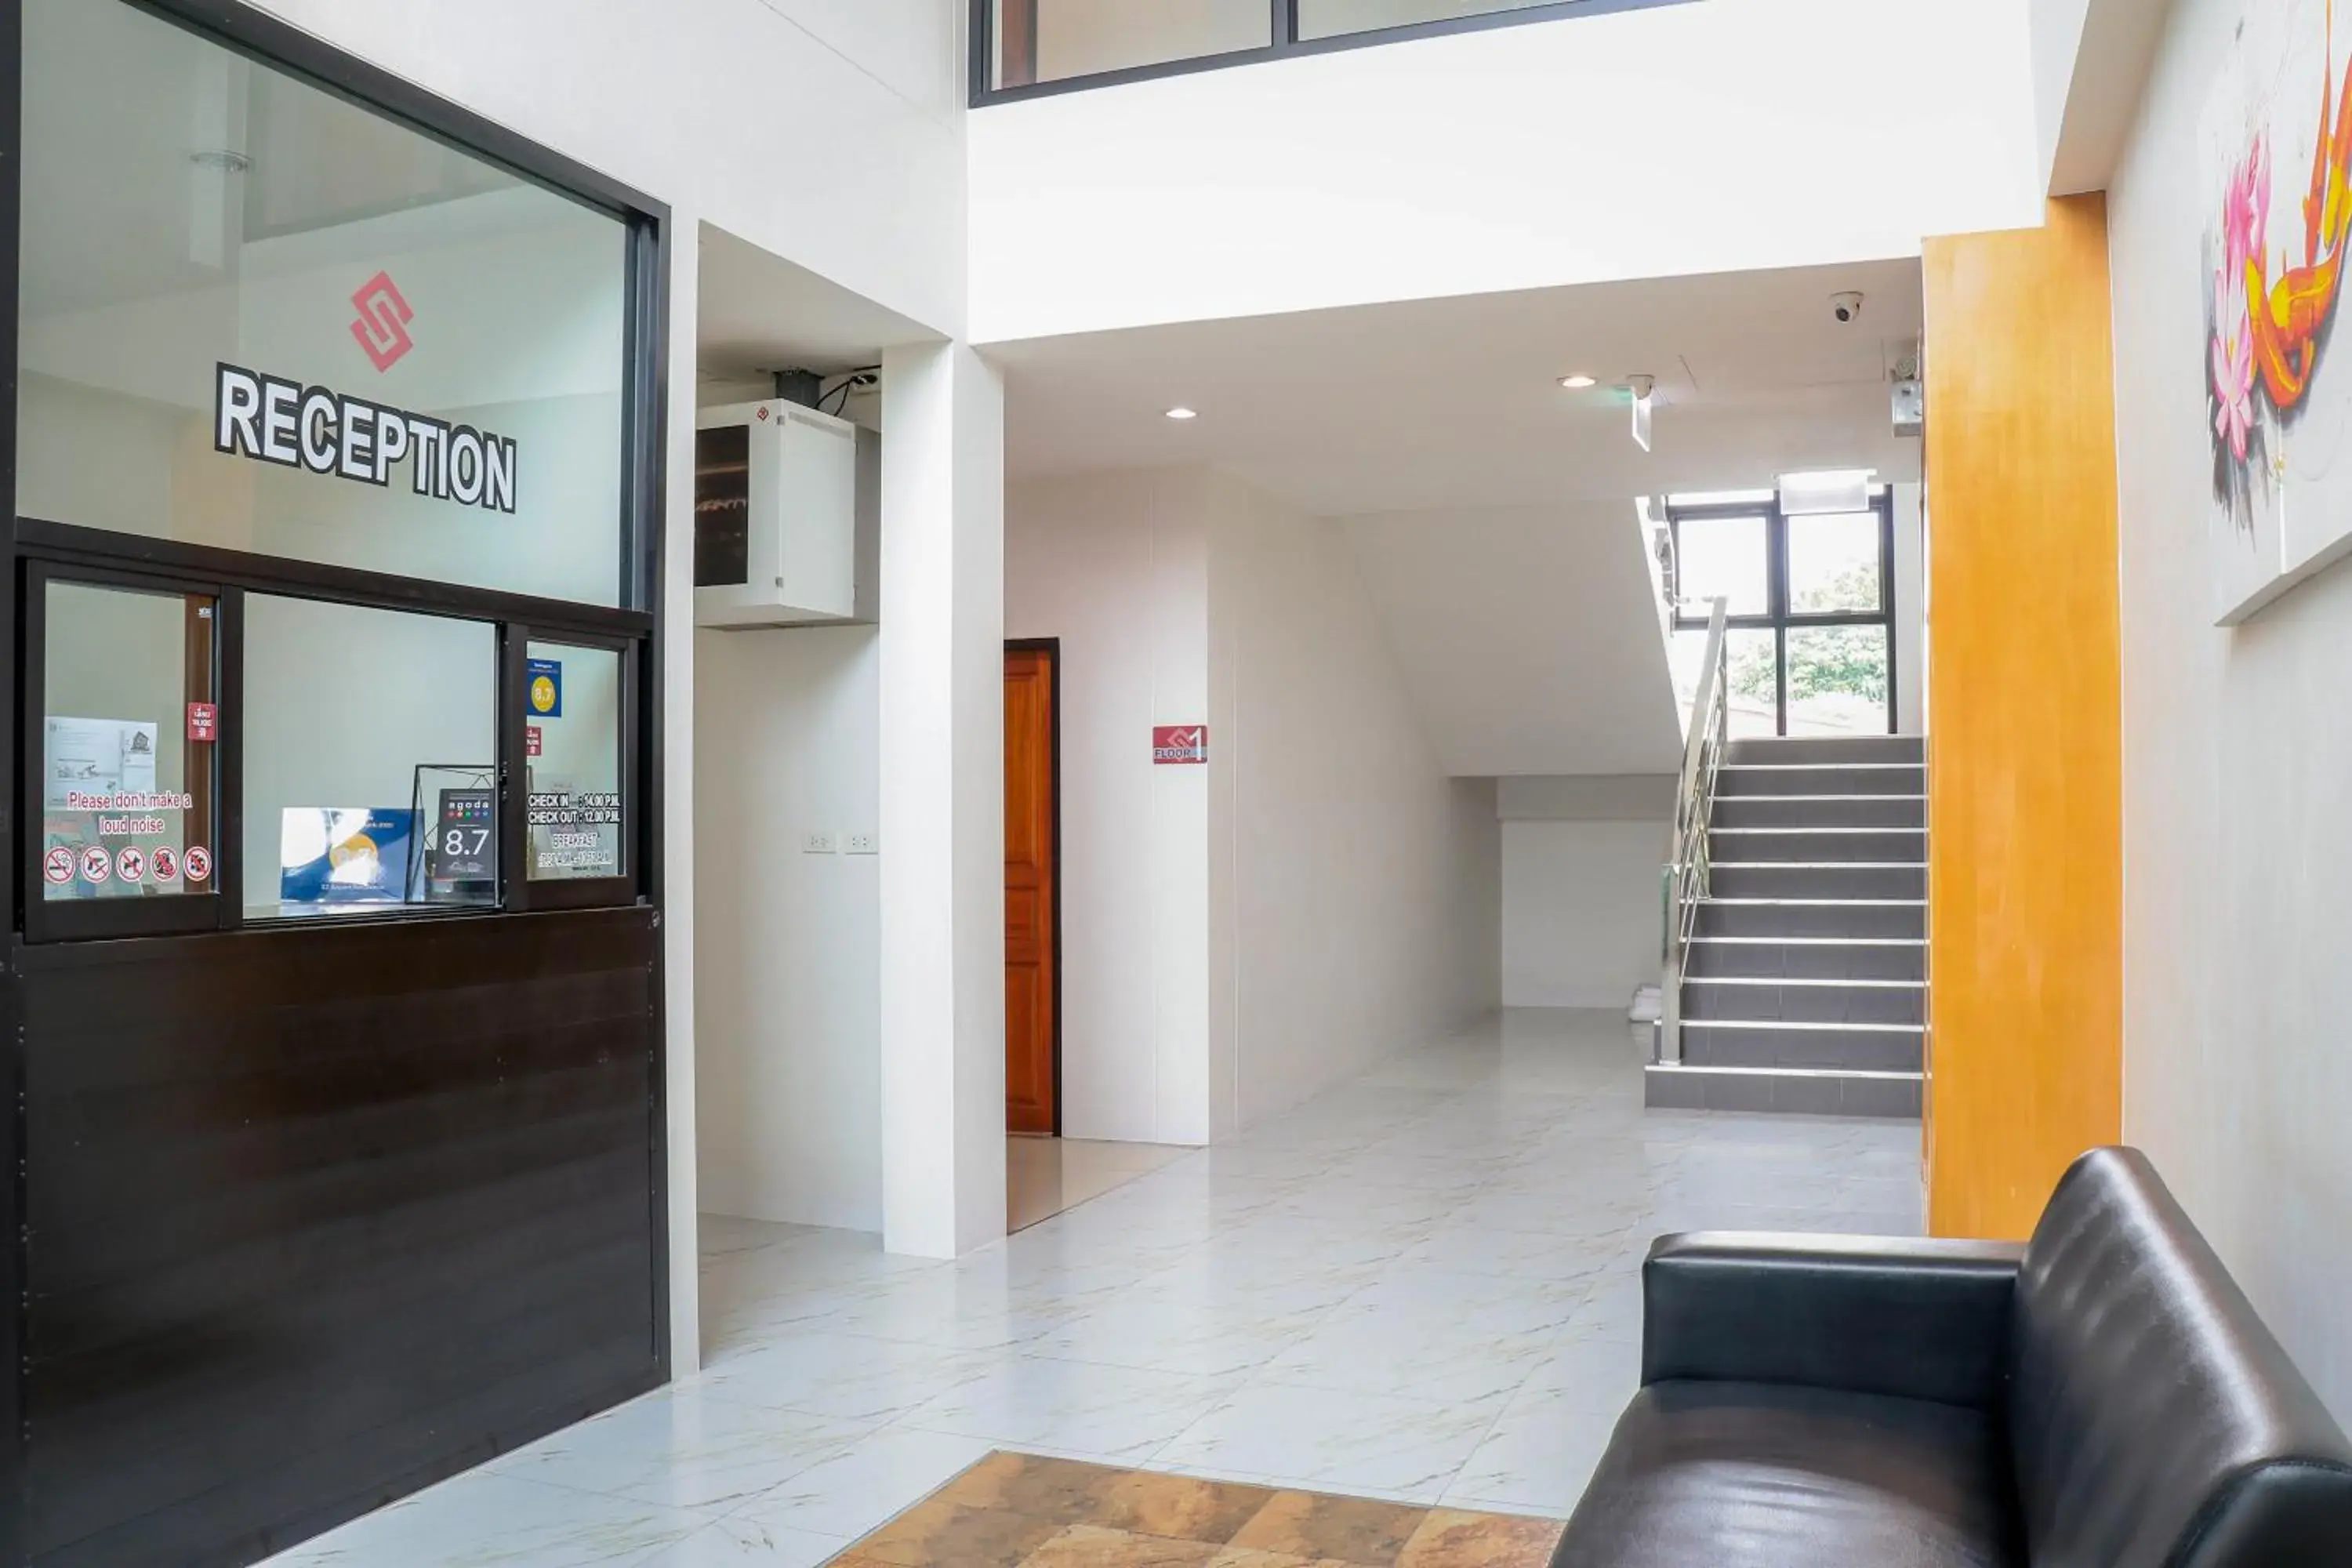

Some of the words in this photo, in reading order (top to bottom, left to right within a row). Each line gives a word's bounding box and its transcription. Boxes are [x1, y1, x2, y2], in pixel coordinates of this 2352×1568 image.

[216, 362, 516, 514] RECEPTION
[1154, 749, 1191, 758] FLOOR
[1189, 727, 1203, 761] 1
[67, 791, 111, 809] Please
[114, 791, 147, 808] don't
[149, 791, 180, 808] make
[183, 793, 193, 808] a
[448, 800, 489, 811] agoda
[528, 793, 559, 808] CHECK
[99, 816, 129, 834] loud
[129, 816, 165, 833] noise
[528, 809, 559, 824] CHECK
[560, 809, 578, 824] OUT
[445, 829, 490, 855] 8.7
